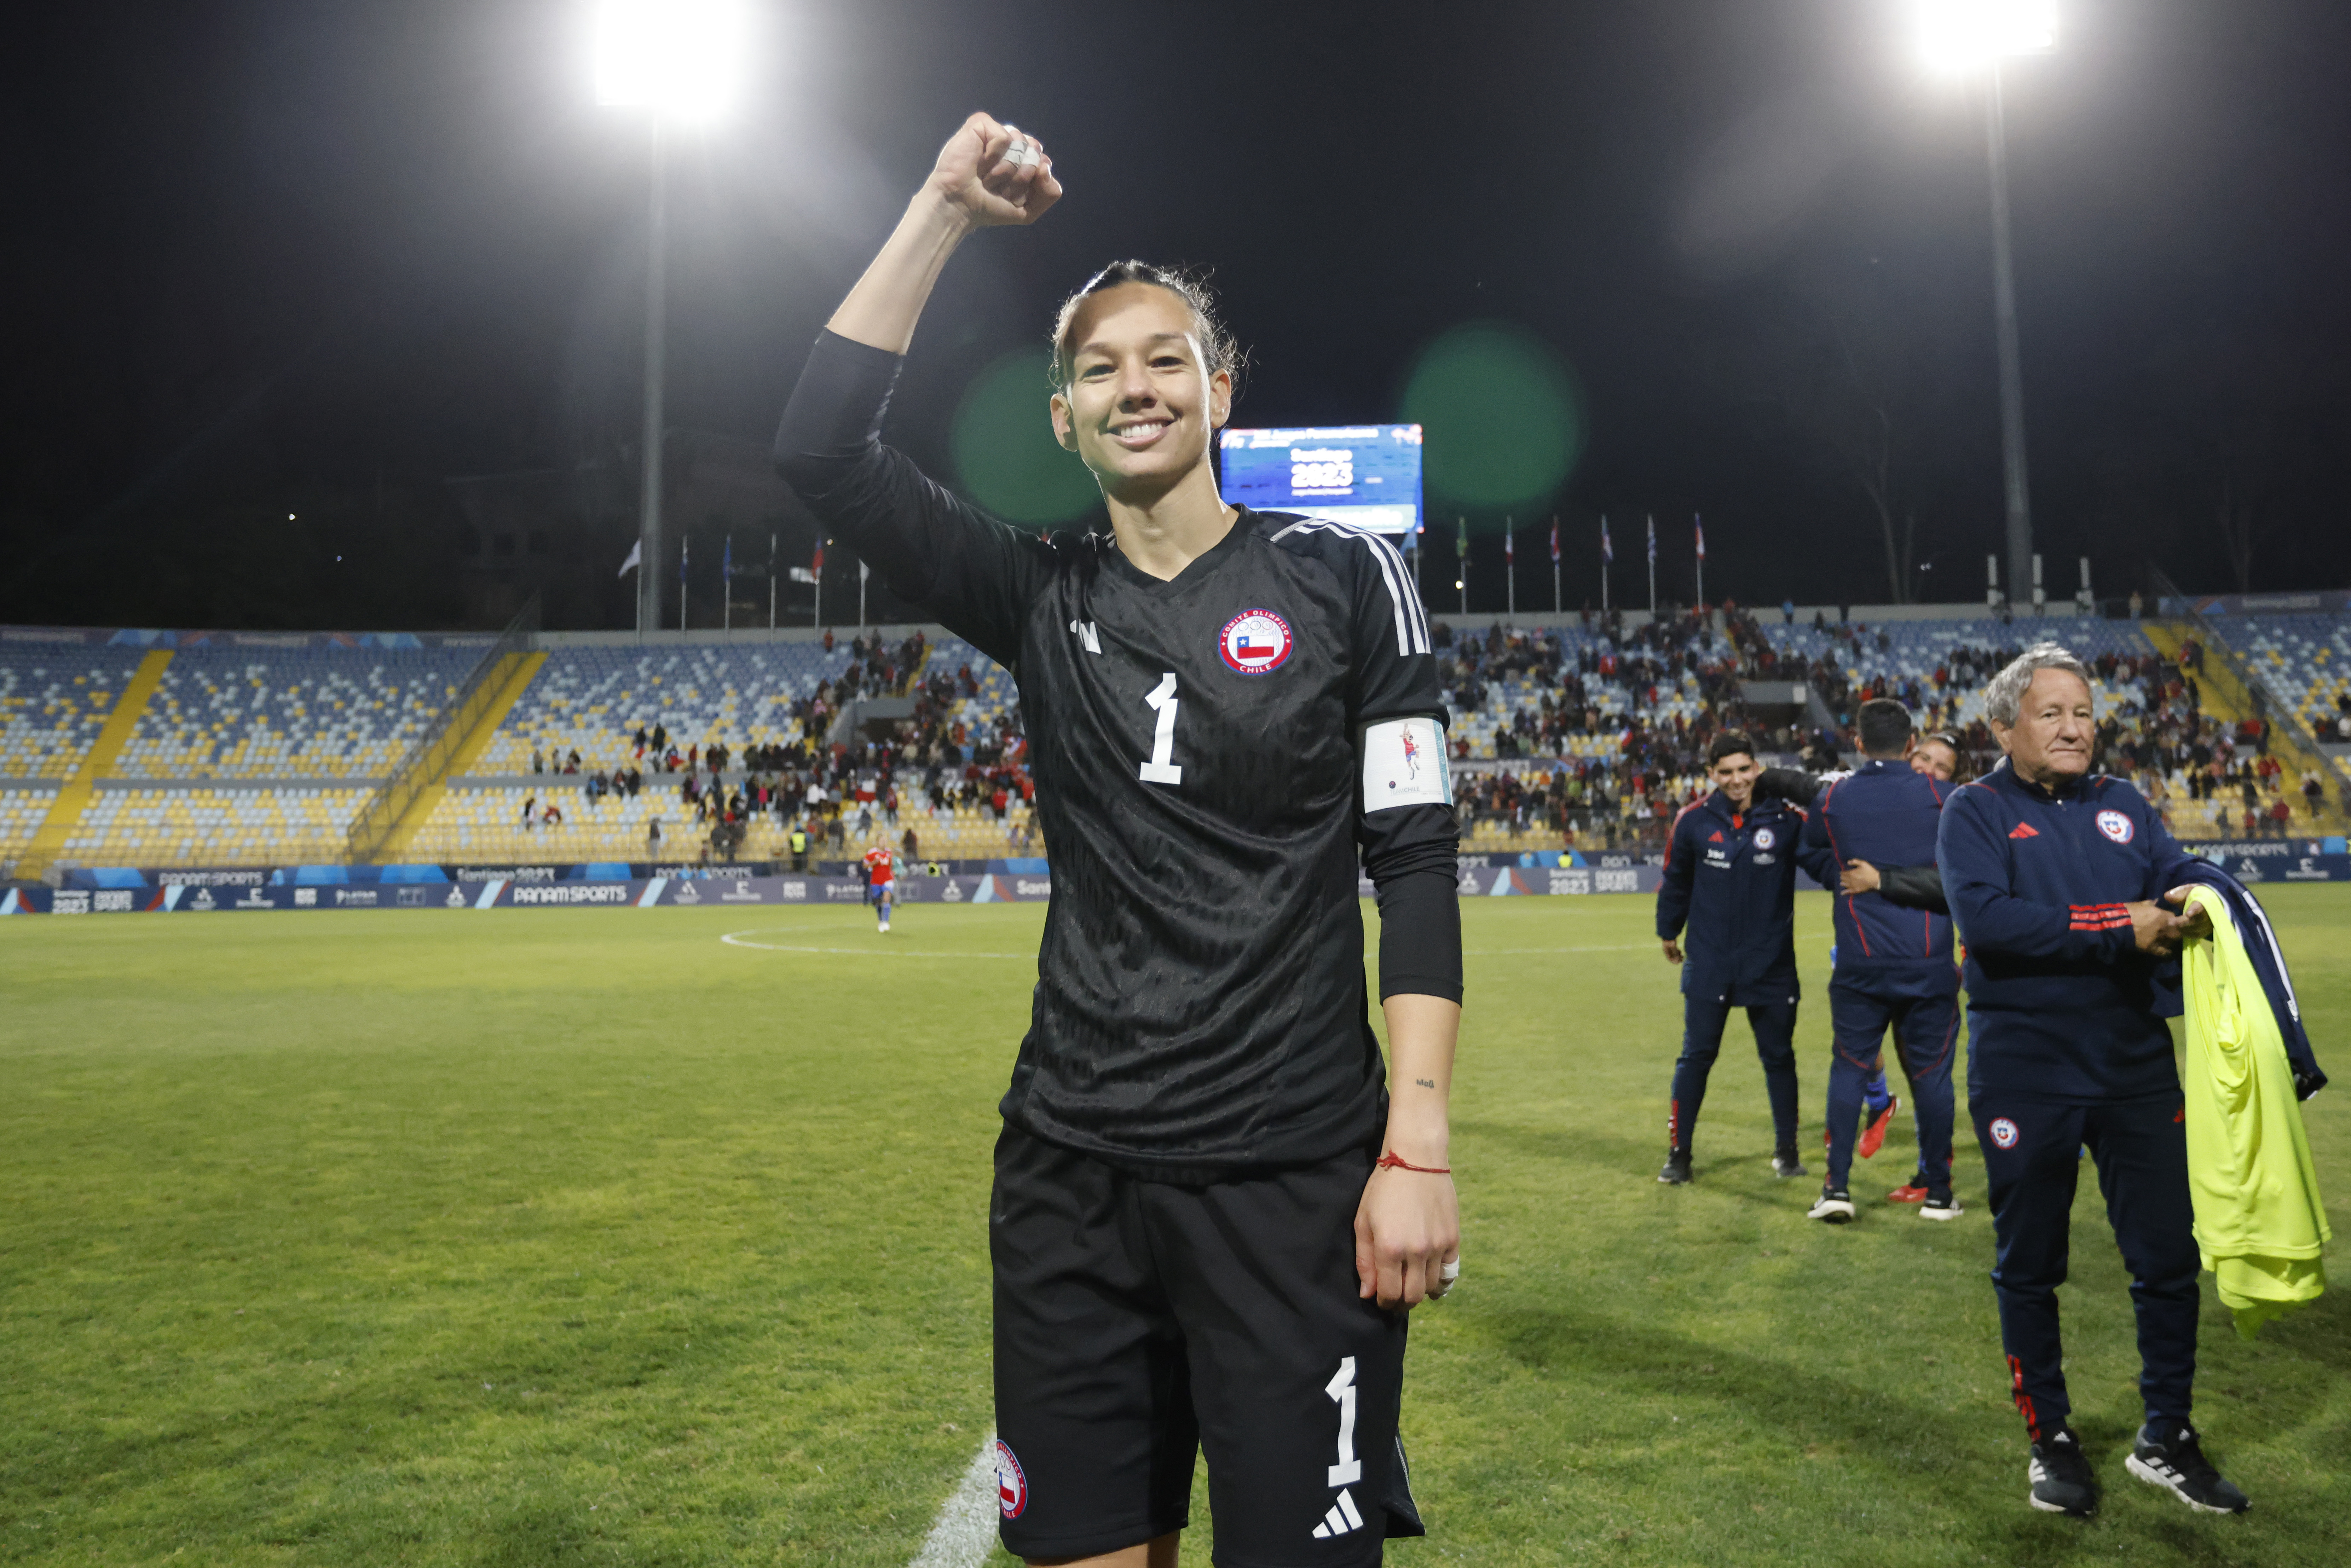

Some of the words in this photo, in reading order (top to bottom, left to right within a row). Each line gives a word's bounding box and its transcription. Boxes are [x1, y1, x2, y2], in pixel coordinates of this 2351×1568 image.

[1291, 463, 1353, 487] 2023
[1222, 612, 1248, 637] COMITE
[1253, 610, 1289, 635] OLIMPICO
[1240, 663, 1272, 673] CHILE
[1139, 673, 1182, 785] 1
[1324, 1356, 1361, 1488] 1
[1000, 1443, 1022, 1479] OLIMPICO
